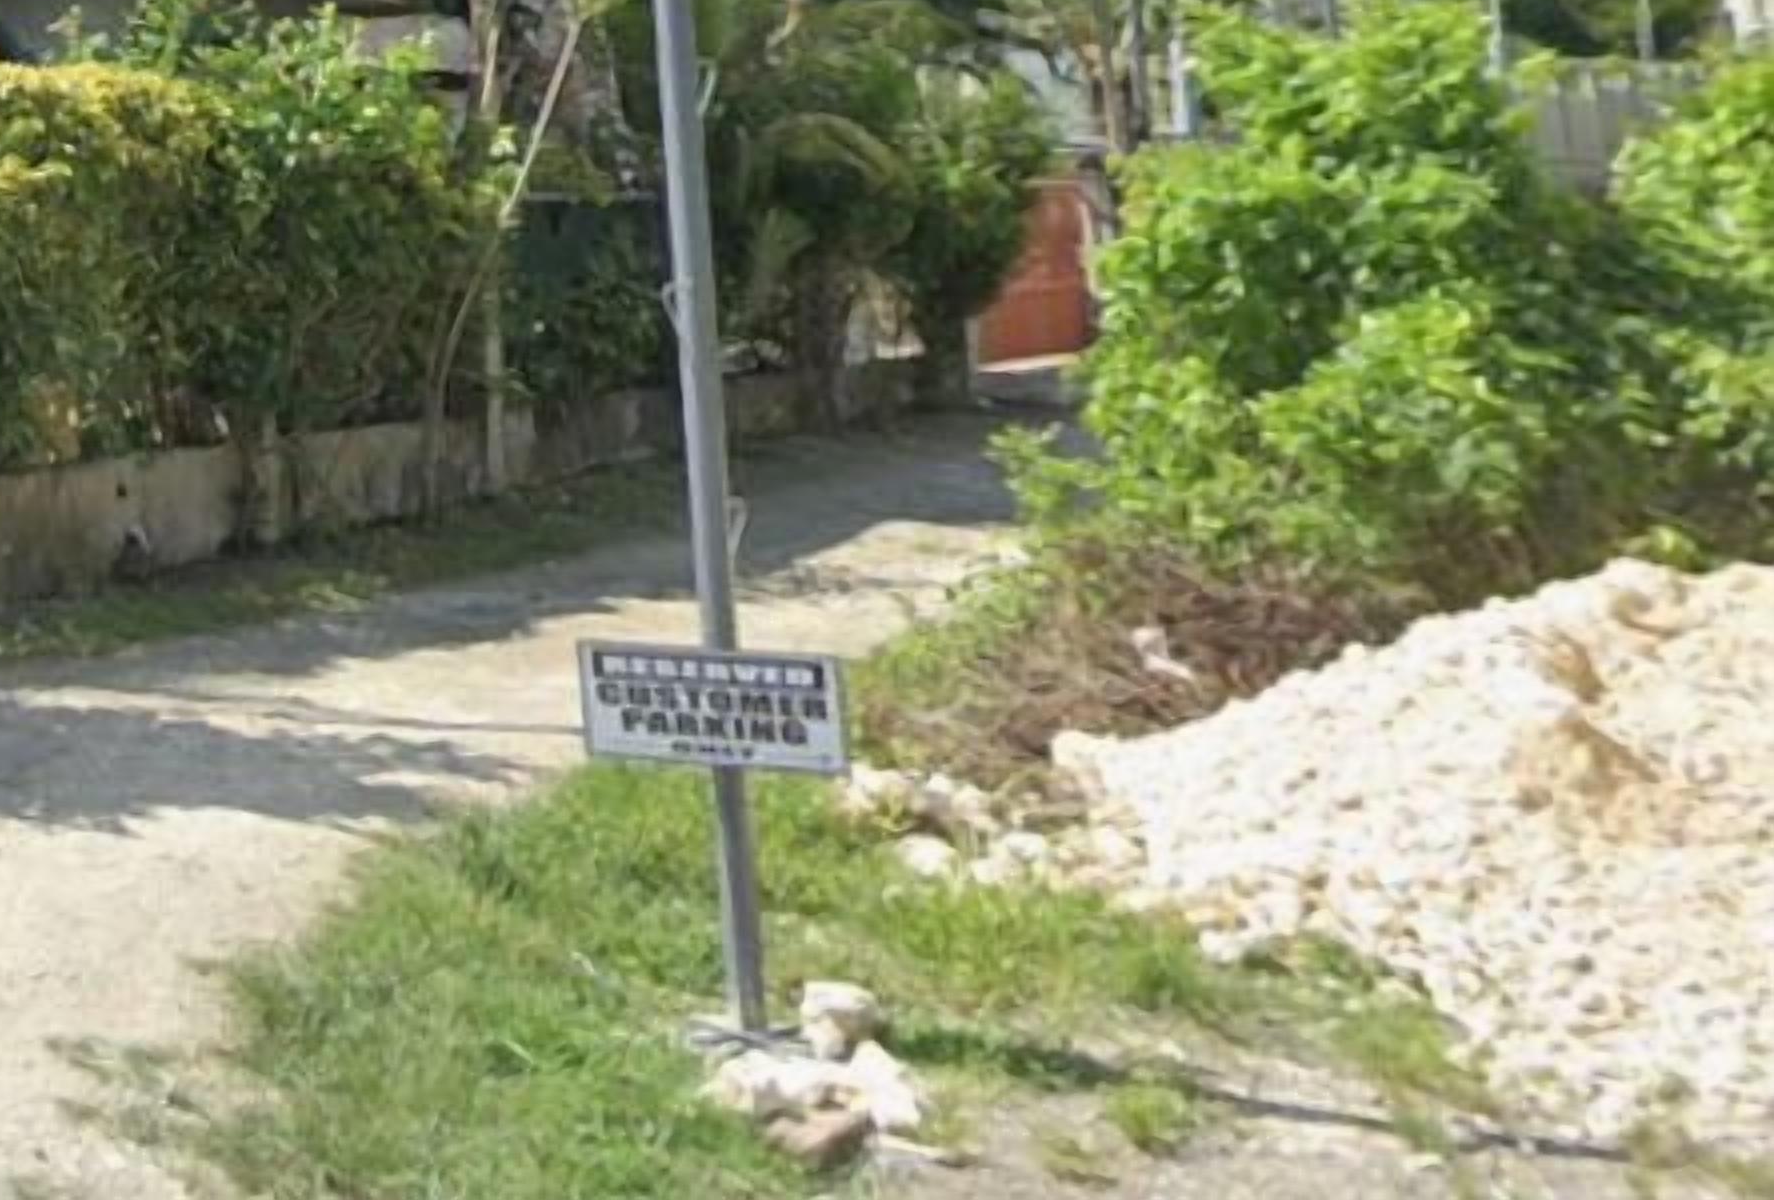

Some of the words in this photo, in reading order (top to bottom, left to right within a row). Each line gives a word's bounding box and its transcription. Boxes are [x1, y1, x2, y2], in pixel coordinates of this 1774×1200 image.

[600, 654, 816, 687] RESERVED
[595, 682, 827, 720] CUSTOMER
[621, 706, 808, 747] PARKING
